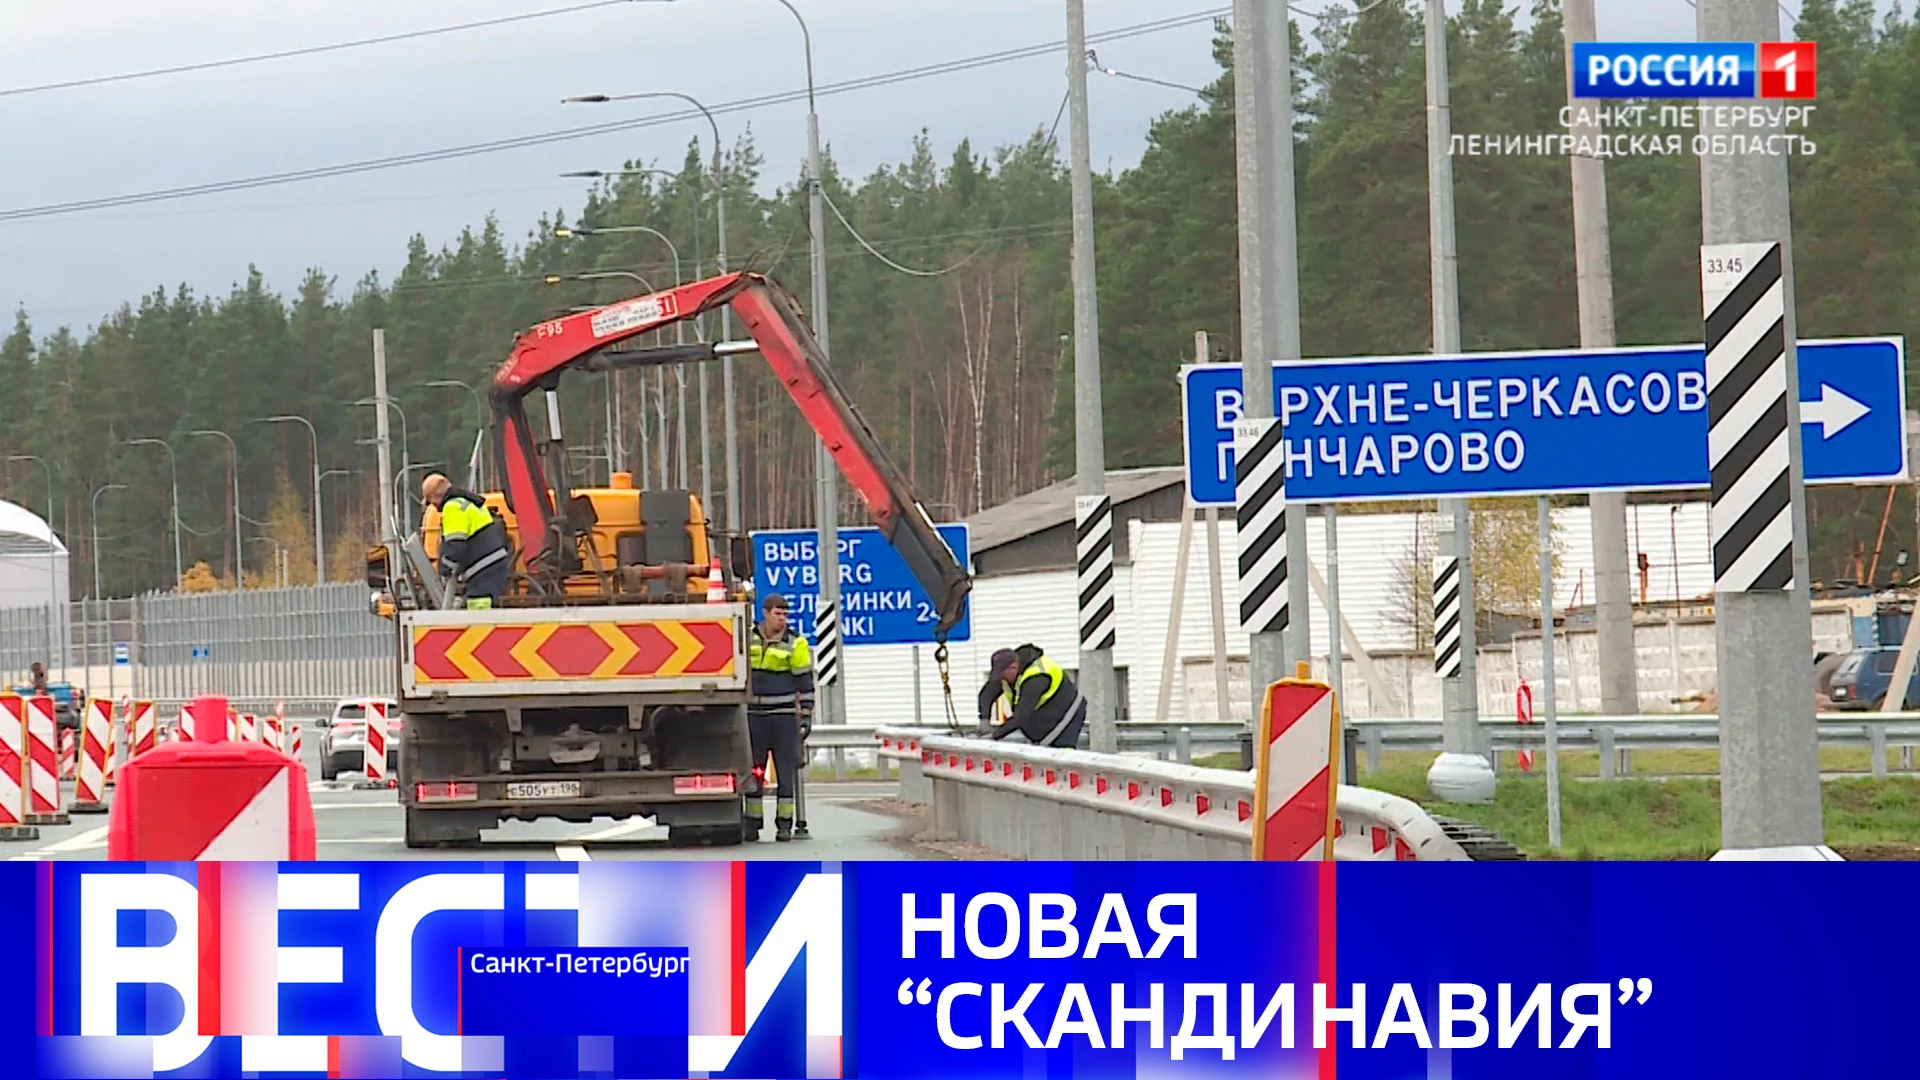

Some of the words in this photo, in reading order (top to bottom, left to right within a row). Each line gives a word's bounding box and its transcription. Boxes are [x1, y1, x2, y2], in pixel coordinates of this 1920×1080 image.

[1707, 257, 1743, 273] 33.45
[1215, 371, 1708, 429] ВРХНЕ-ЧЕРКАСОВ
[1217, 429, 1525, 481] ГНЧАРОВО
[764, 538, 861, 562] ВЫБРГ
[765, 563, 872, 586] VYBRG
